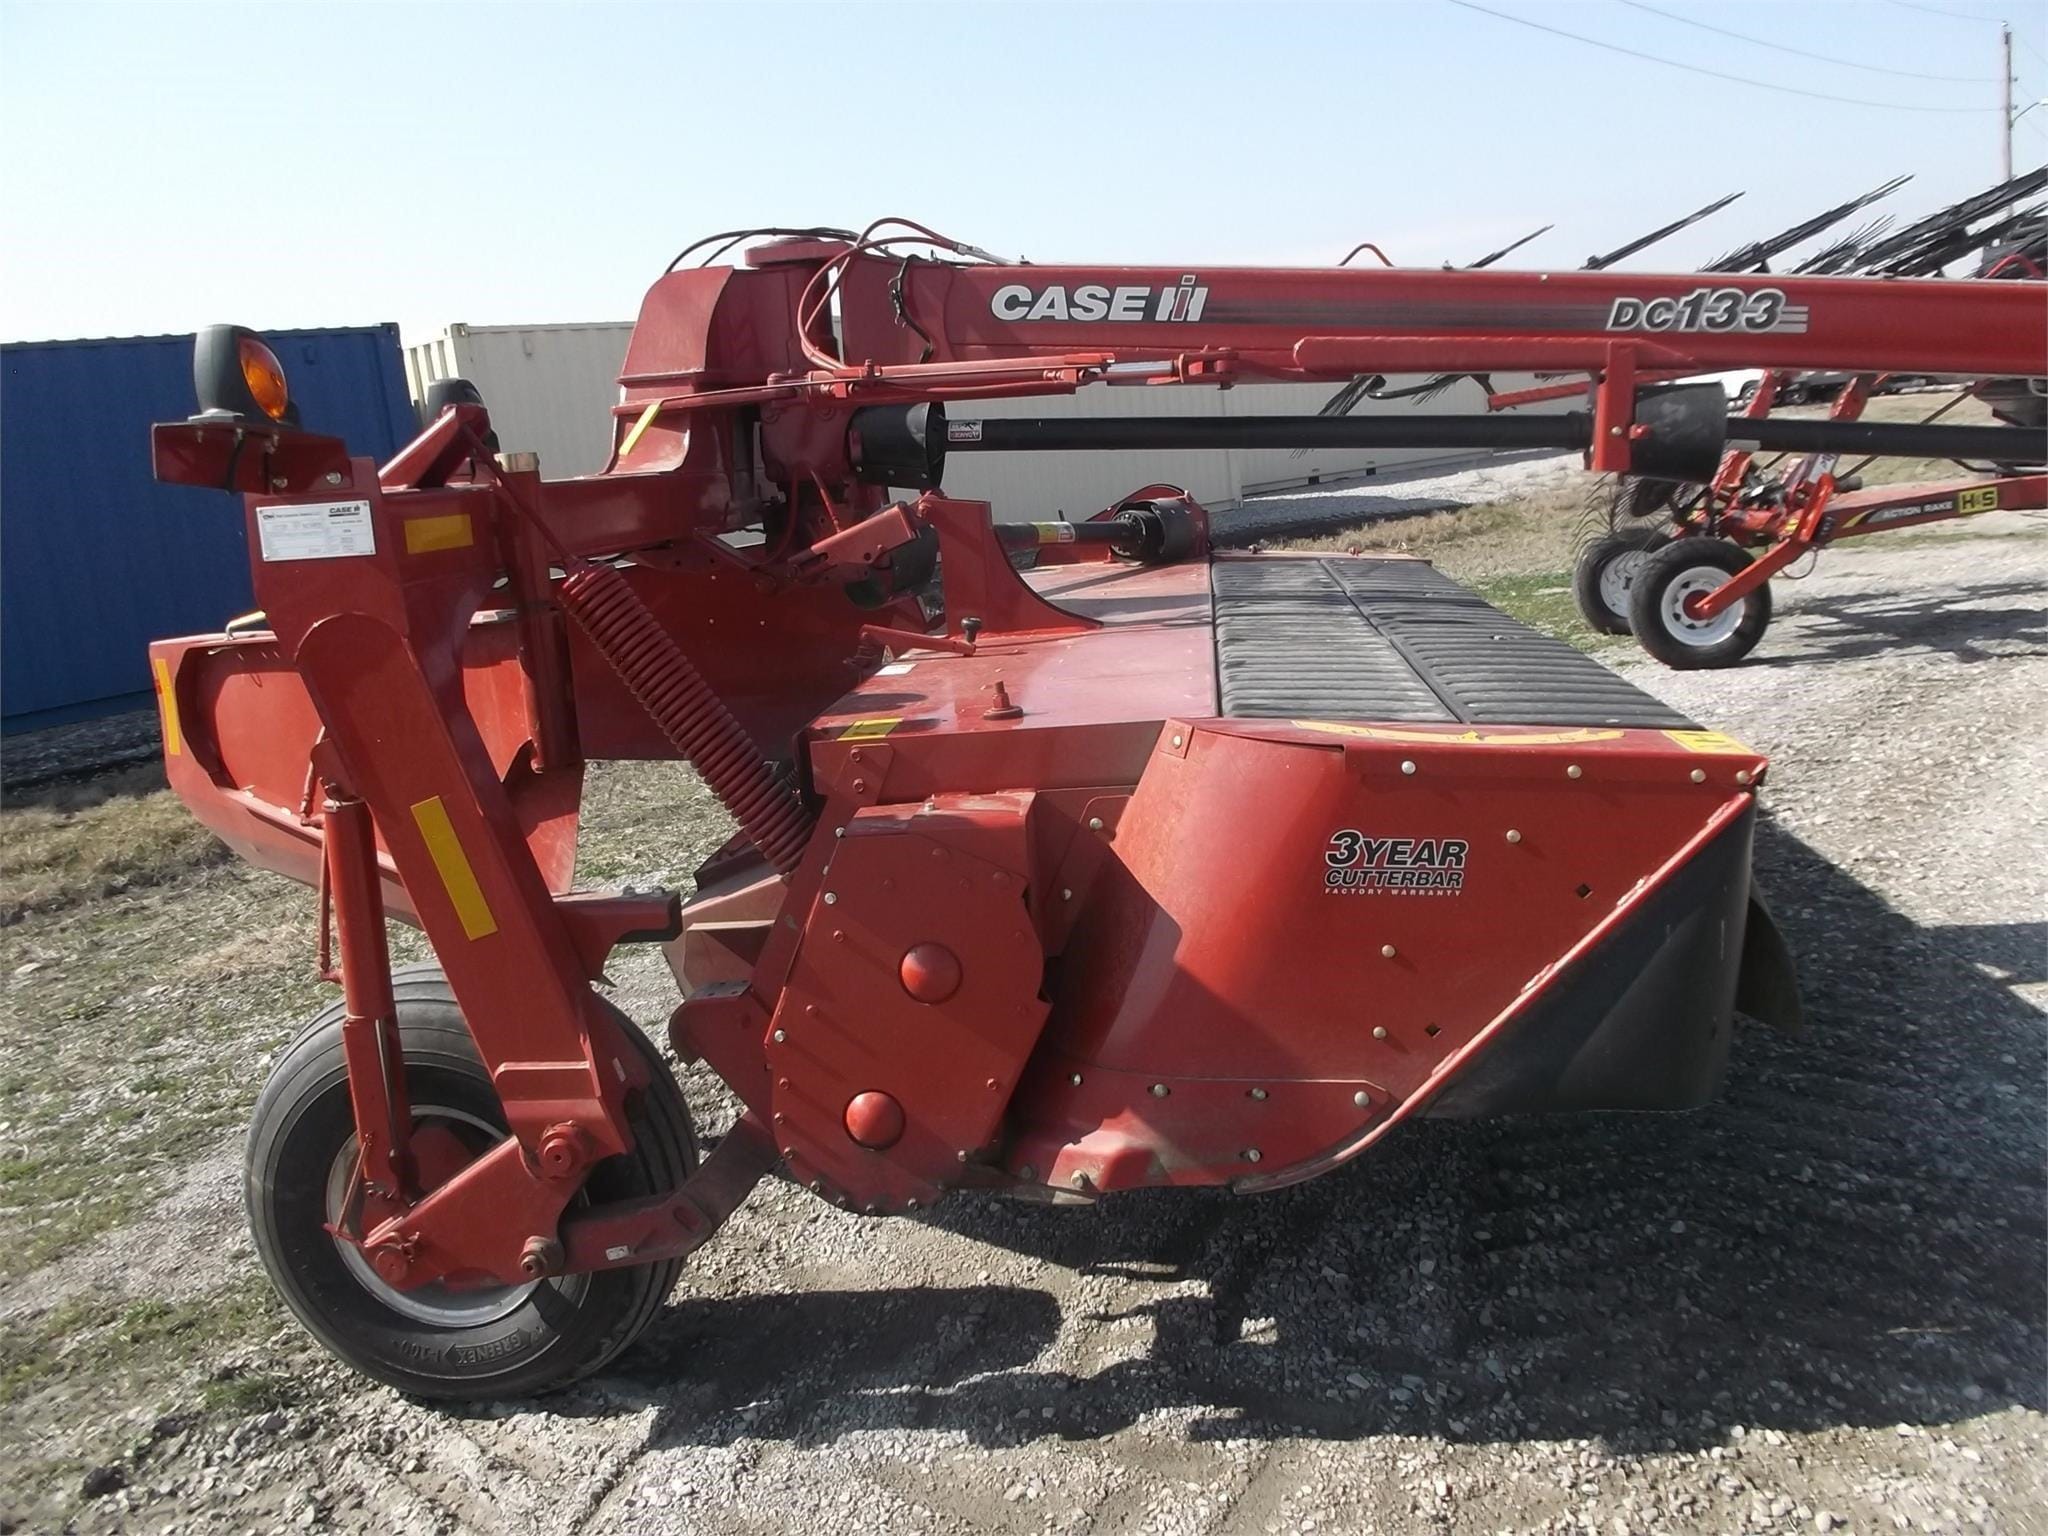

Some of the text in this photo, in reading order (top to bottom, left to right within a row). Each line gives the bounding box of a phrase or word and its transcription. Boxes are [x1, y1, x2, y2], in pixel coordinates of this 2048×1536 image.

[991, 284, 1151, 322] CASE
[1606, 288, 1787, 334] DC133
[1882, 505, 1922, 519] ACTION
[1923, 500, 1954, 513] RAKE
[1324, 867, 1465, 889] CUTTERBAR
[1324, 887, 1463, 897] FACTORY WARRANTY
